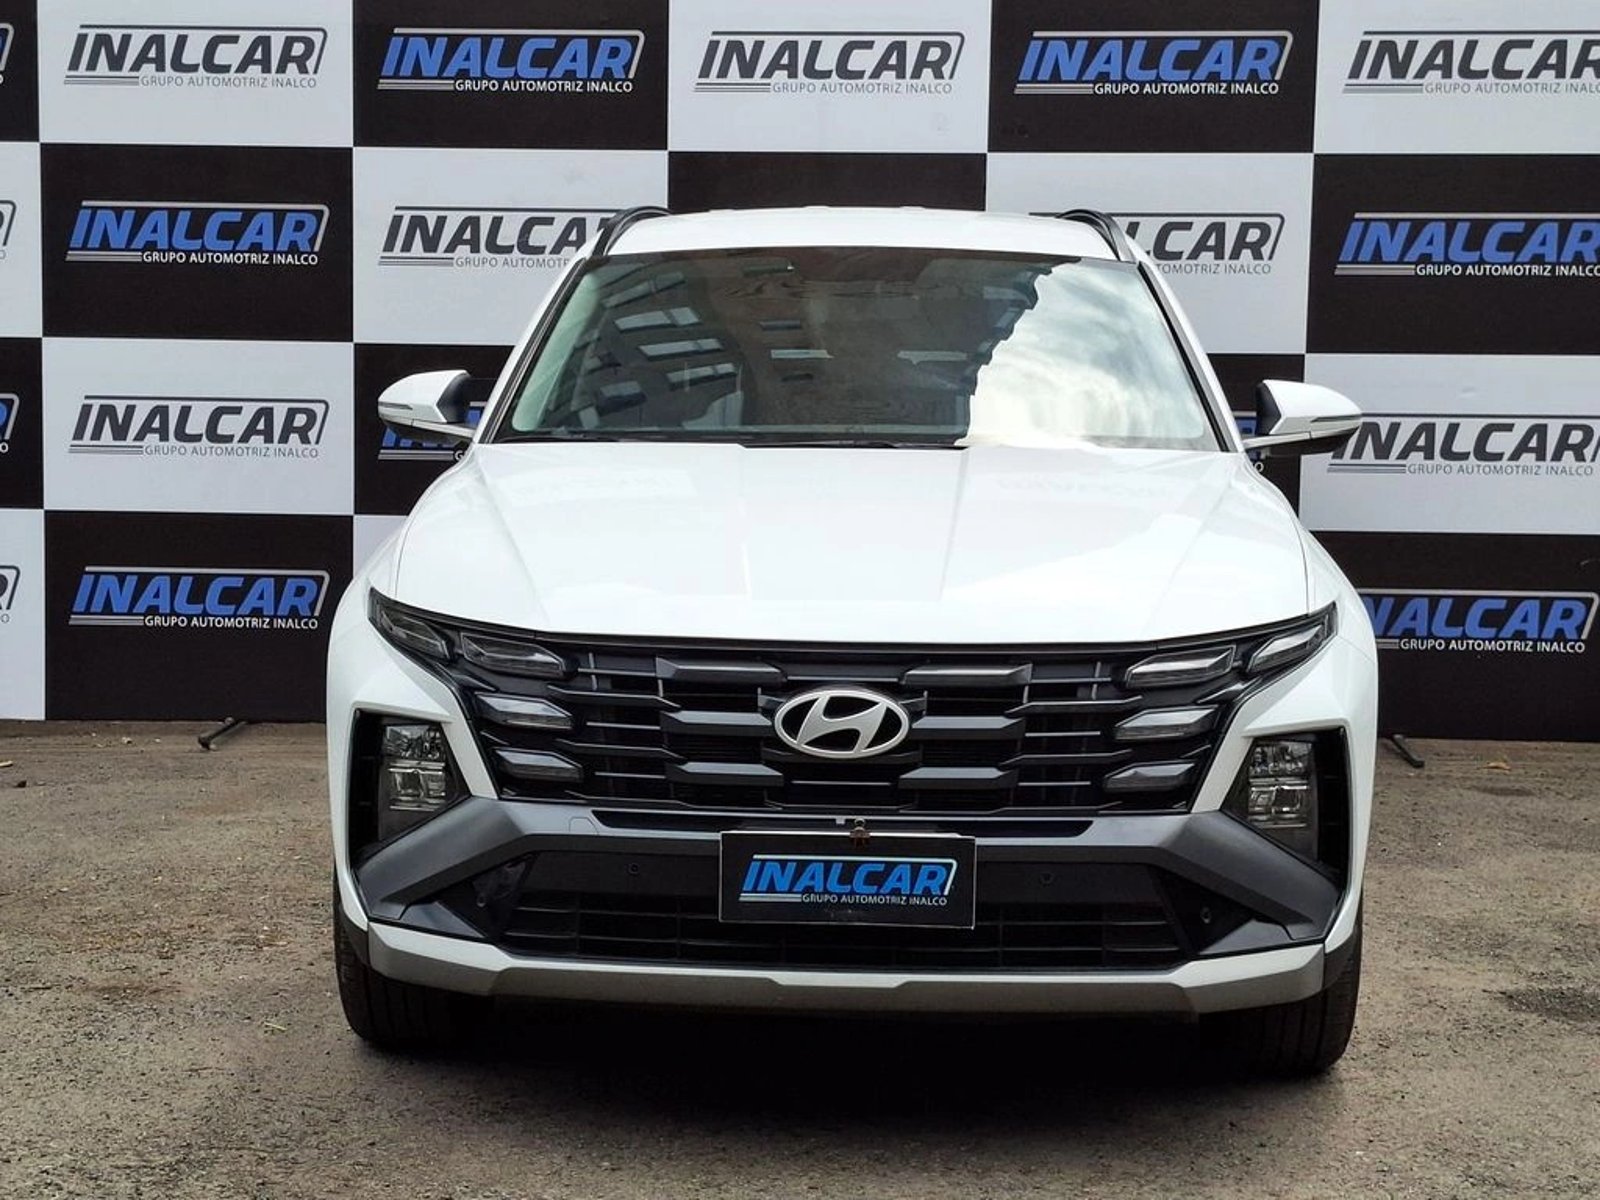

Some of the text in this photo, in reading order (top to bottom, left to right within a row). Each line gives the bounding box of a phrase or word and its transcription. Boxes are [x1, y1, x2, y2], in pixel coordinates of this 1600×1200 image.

[67, 33, 316, 75] INALCAR
[380, 36, 632, 79] INALCAR
[698, 39, 952, 80] INALCAR
[1018, 39, 1280, 81] INALCAR
[140, 75, 317, 88] GRUPO AUTOMOTRIZ INALCO
[455, 80, 633, 92] GRUPO AUTOMOTRIZ INALCO
[772, 82, 952, 94] GRUPO AUTOMOTRIZ INALCO
[1425, 83, 1471, 94] GRUPO
[1475, 83, 1560, 94] AUTOMOTRIZ
[1094, 83, 1279, 95] GRUPO AUTOMOTRIZ INALCO
[69, 209, 317, 252] INALCAR
[382, 214, 613, 255] INALCA
[1338, 221, 1600, 263] INALCAR
[143, 251, 318, 265] GRUPO AUTOMOTRIZ INALCO
[455, 256, 498, 268] GRUPO
[1224, 263, 1271, 275] INALCO
[1416, 264, 1462, 276] GRUPO
[1465, 264, 1551, 276] AUTOMOTRIZ
[72, 403, 318, 445] INALCAR
[144, 445, 319, 458] GRUPO AUTOMOTRIZ INALCO
[1407, 463, 1593, 476] GRUPO AUTOMOTRIZ INALCO
[72, 574, 318, 616] INALCAR
[144, 615, 318, 629] GRUPO AUTOMOTRIZ INALCO
[1400, 638, 1585, 653] GRUPO AUTOMOTRIZ INALCO
[742, 860, 947, 894] INALCAR
[802, 893, 947, 906] GRUPO AUTOMOTRIZ INALCO
